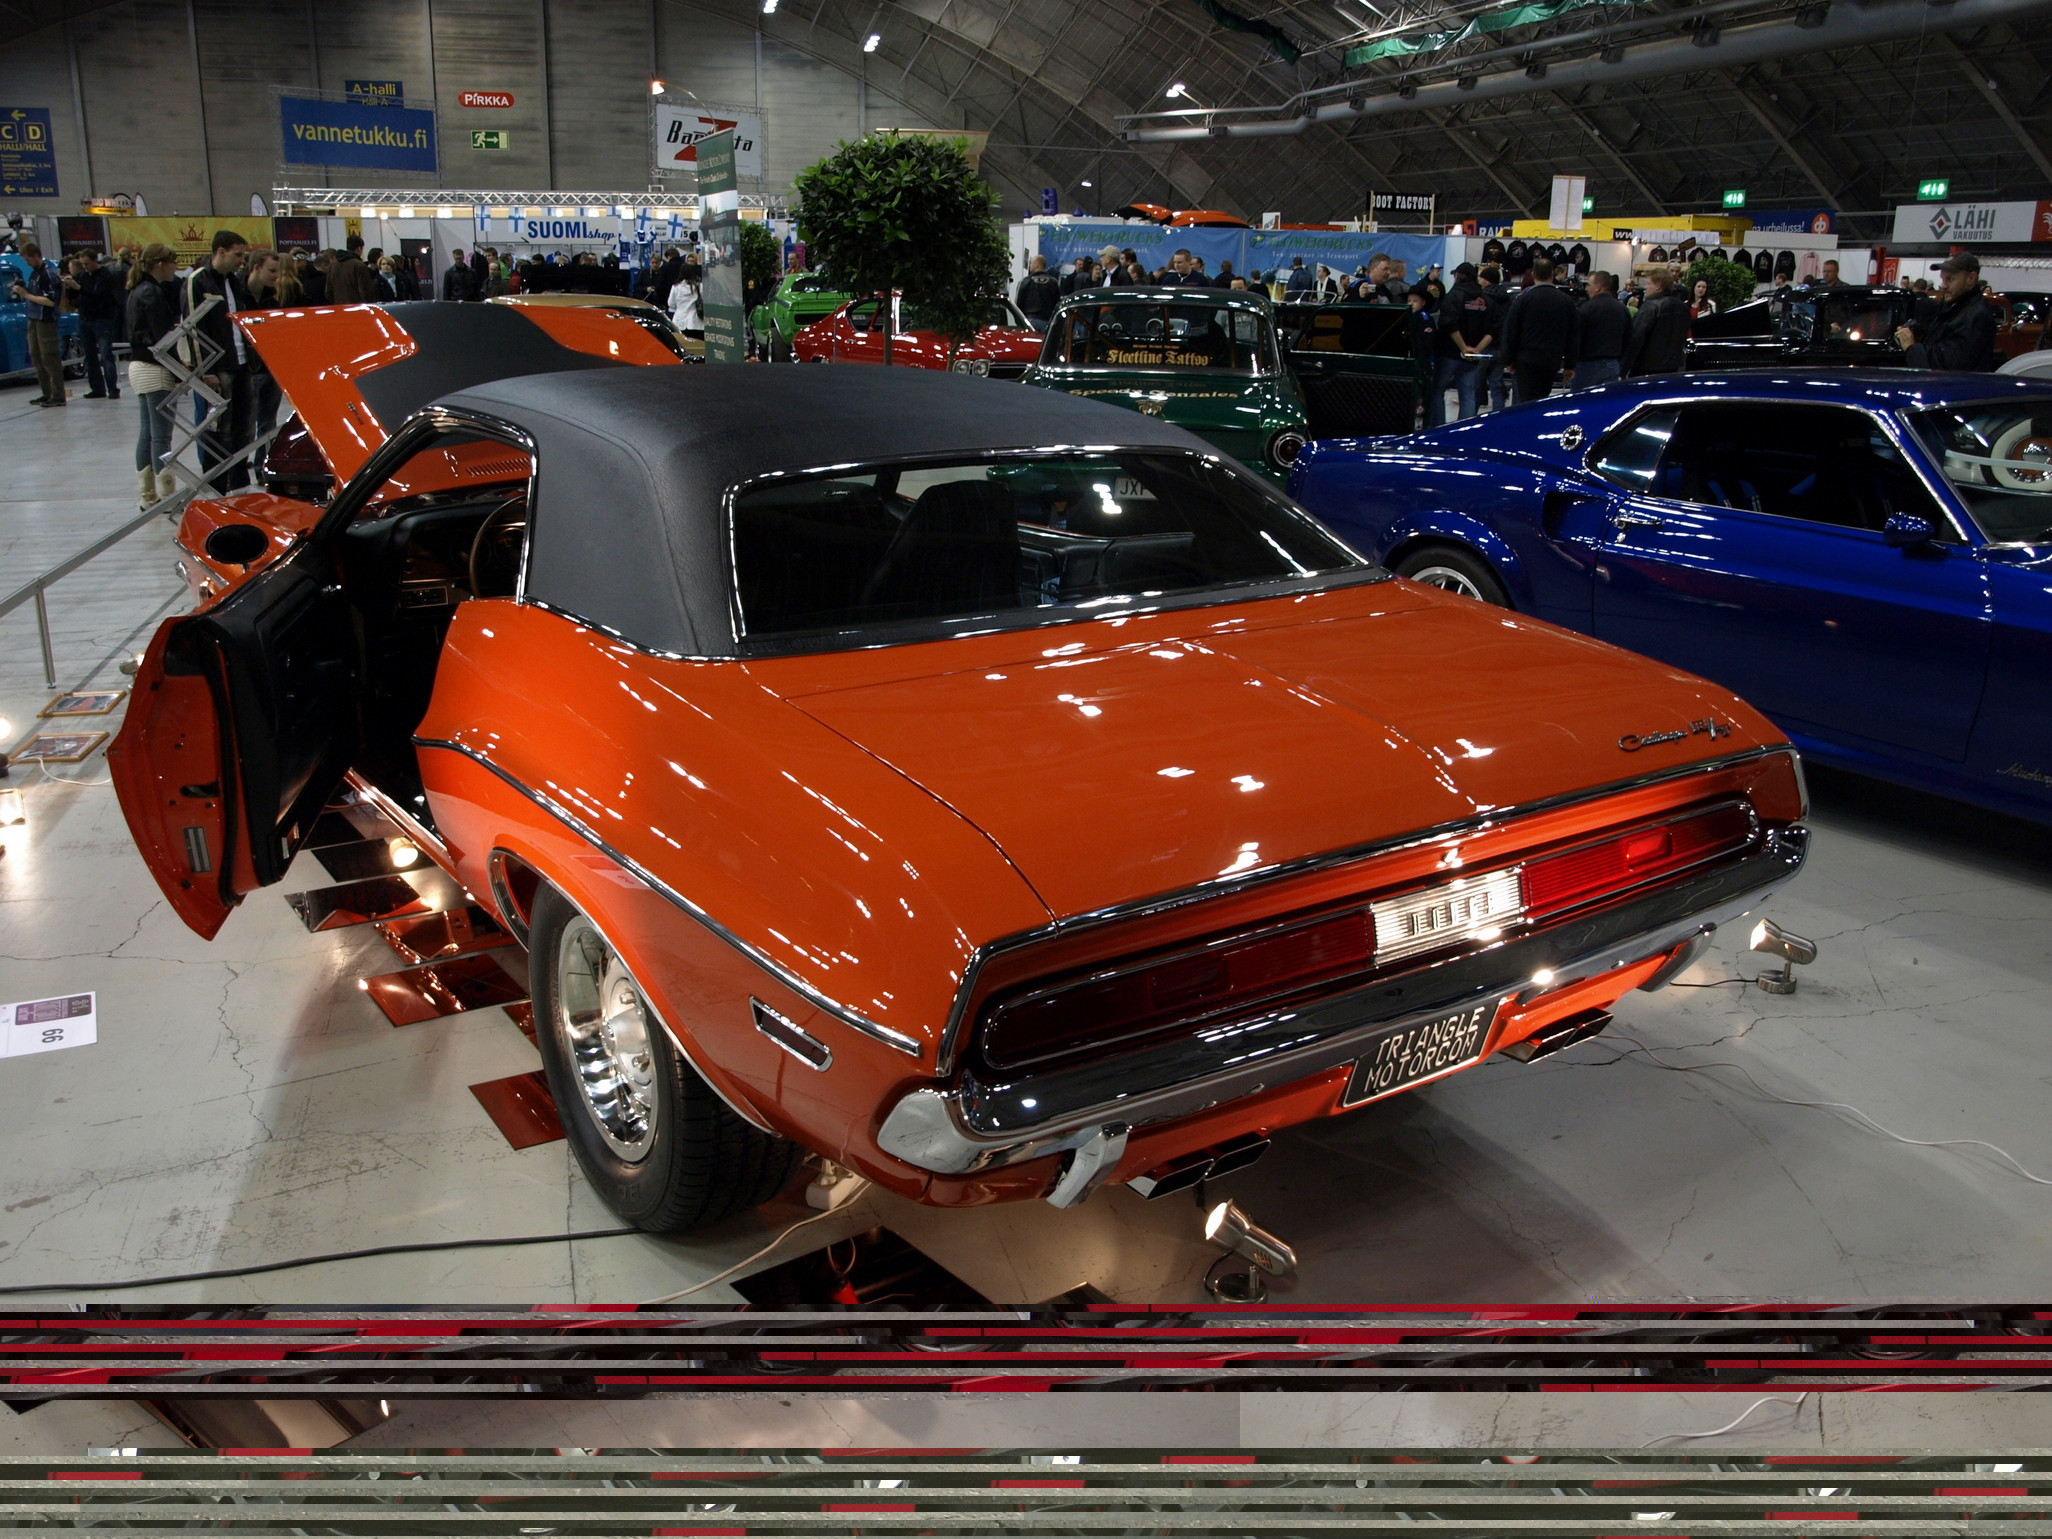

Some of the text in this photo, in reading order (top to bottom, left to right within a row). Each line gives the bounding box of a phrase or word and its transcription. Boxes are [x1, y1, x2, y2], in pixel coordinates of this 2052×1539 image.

[352, 82, 397, 96] A-halli
[1, 125, 42, 140] C D
[292, 123, 428, 149] vannetukku.fi
[1953, 204, 1997, 230] LÄHI
[1050, 229, 1164, 245] FLOWERTRUCKS
[1269, 235, 1375, 251] FLOWERTRUCKS
[1952, 230, 1993, 241] VAKUUTUS
[1164, 350, 1210, 367] Tattoo
[1375, 1006, 1486, 1065] TRIANGLE
[1363, 1031, 1478, 1093] MOTORCOM
